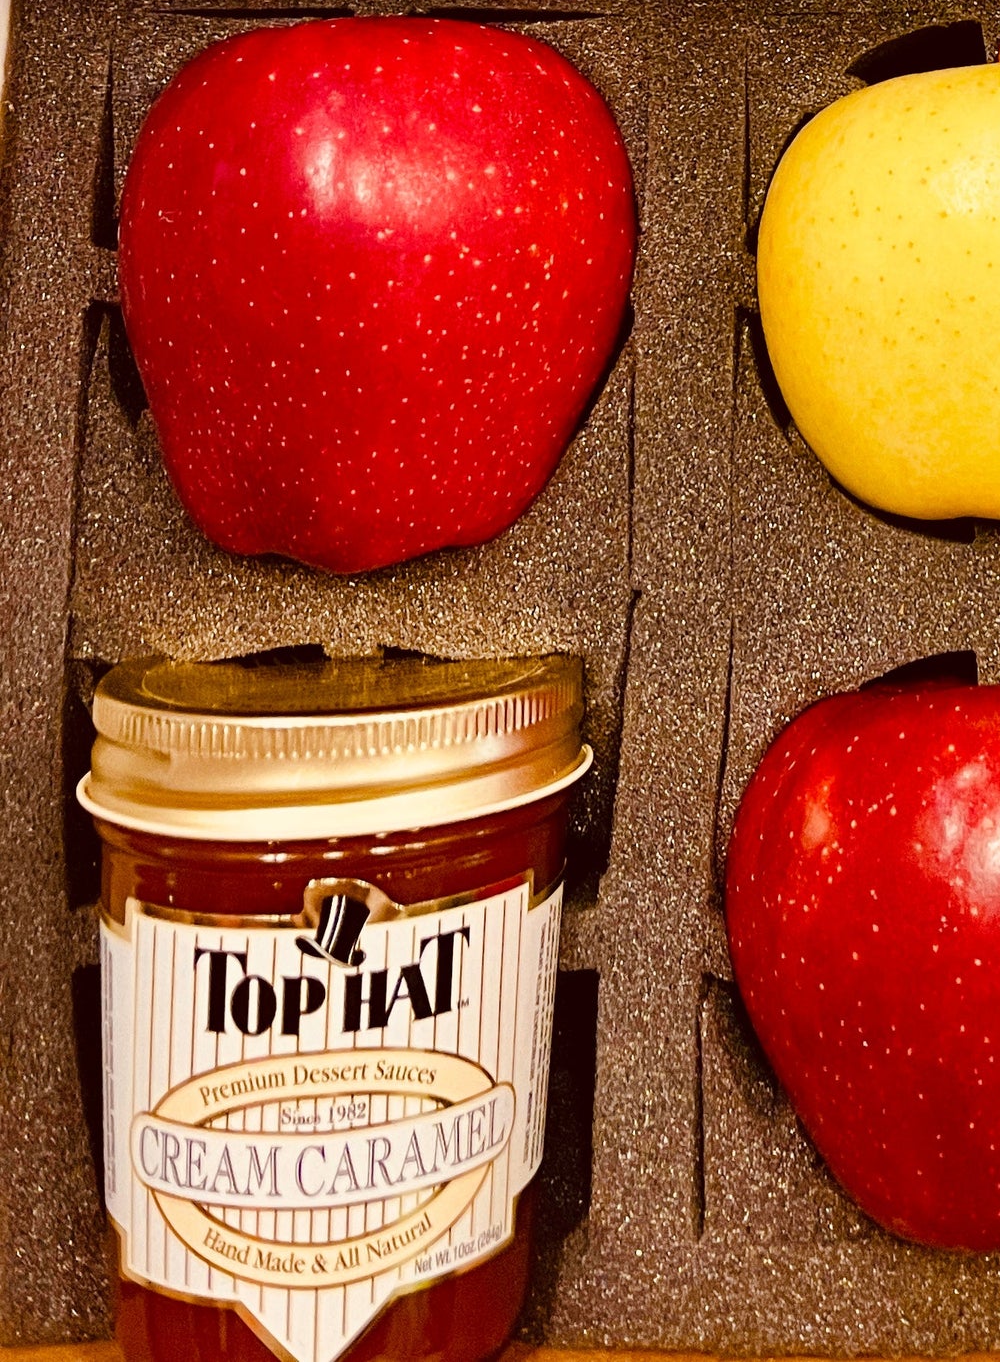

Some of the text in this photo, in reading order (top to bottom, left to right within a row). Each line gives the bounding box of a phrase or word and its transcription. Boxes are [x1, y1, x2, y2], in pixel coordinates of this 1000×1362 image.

[193, 947, 326, 1037] TOP
[342, 926, 470, 1035] HAT
[199, 1059, 437, 1107] Premium Dessert Sauces
[280, 1102, 367, 1125] Since 1982
[139, 1096, 507, 1198] CREAM CARAMEL
[202, 1211, 433, 1275] Hand Made & All Natural
[414, 1254, 432, 1276] Net
